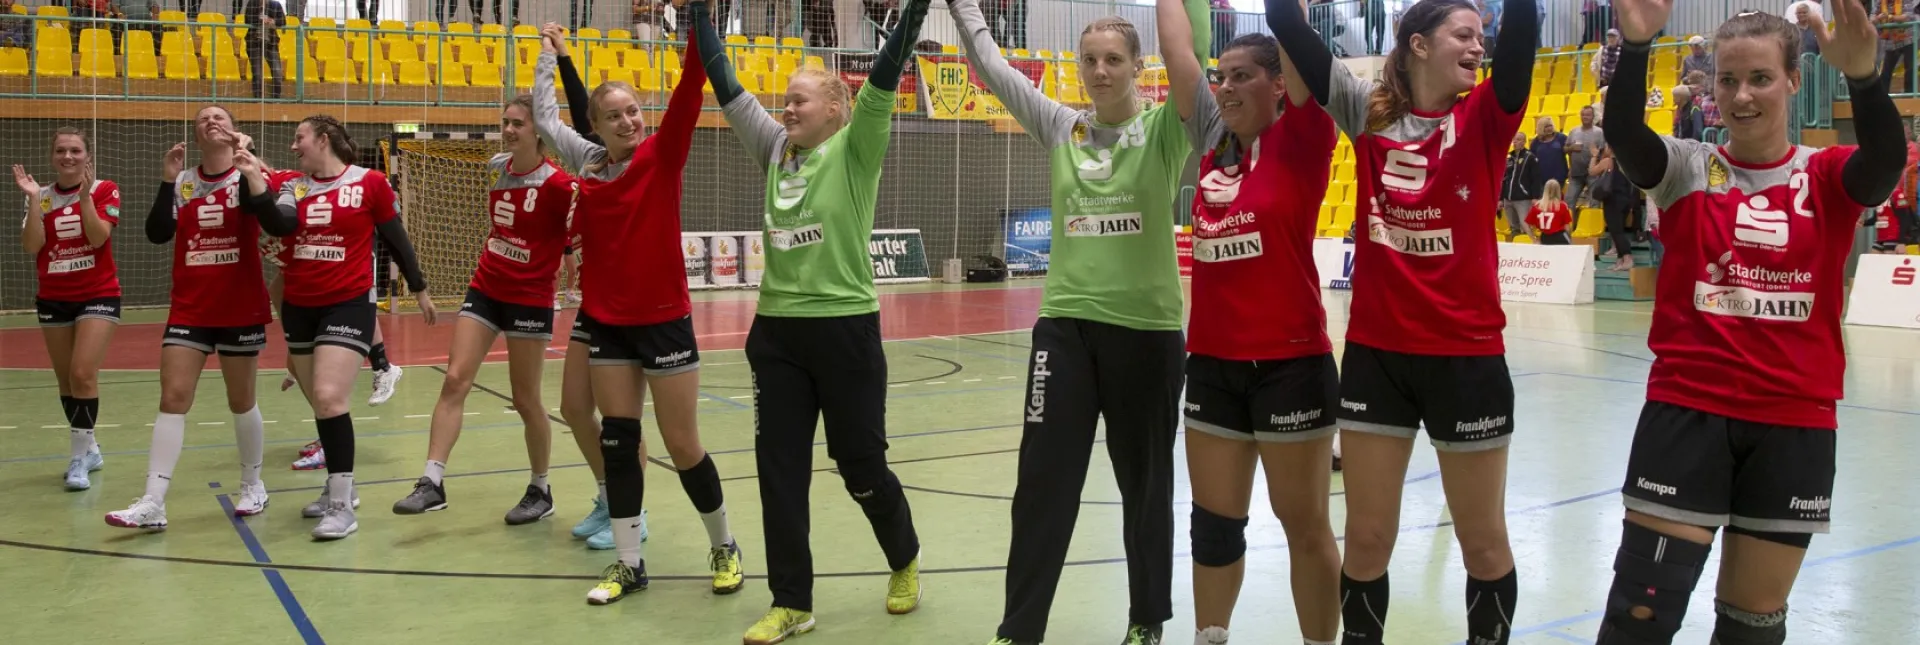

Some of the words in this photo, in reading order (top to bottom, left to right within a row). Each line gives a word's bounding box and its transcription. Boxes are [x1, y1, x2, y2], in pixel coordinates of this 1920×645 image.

[940, 67, 964, 86] FHC
[225, 184, 240, 209] 3
[337, 185, 364, 209] 66
[523, 187, 538, 213] 8
[1079, 192, 1135, 207] stadtwerke
[1099, 217, 1141, 235] JAHN
[1536, 211, 1555, 230] 17
[1213, 238, 1262, 261] JAHN
[1404, 235, 1450, 251] JAHN
[214, 252, 240, 264] JAHN
[314, 249, 345, 260] JAHN
[504, 245, 529, 262] JAHN
[69, 258, 94, 271] JAHN
[1728, 263, 1812, 284] stadtwerke
[1728, 278, 1765, 290] FRANKFURT
[1766, 283, 1791, 291] (ODER)
[1752, 297, 1812, 318] JAHN
[513, 319, 546, 330] Frankfurter
[655, 350, 693, 366] Frankfurter
[1026, 350, 1052, 423] Kempa
[1270, 408, 1322, 426] Frankfurter
[1455, 415, 1507, 434] Frankfurter
[1637, 477, 1677, 496] Kempa
